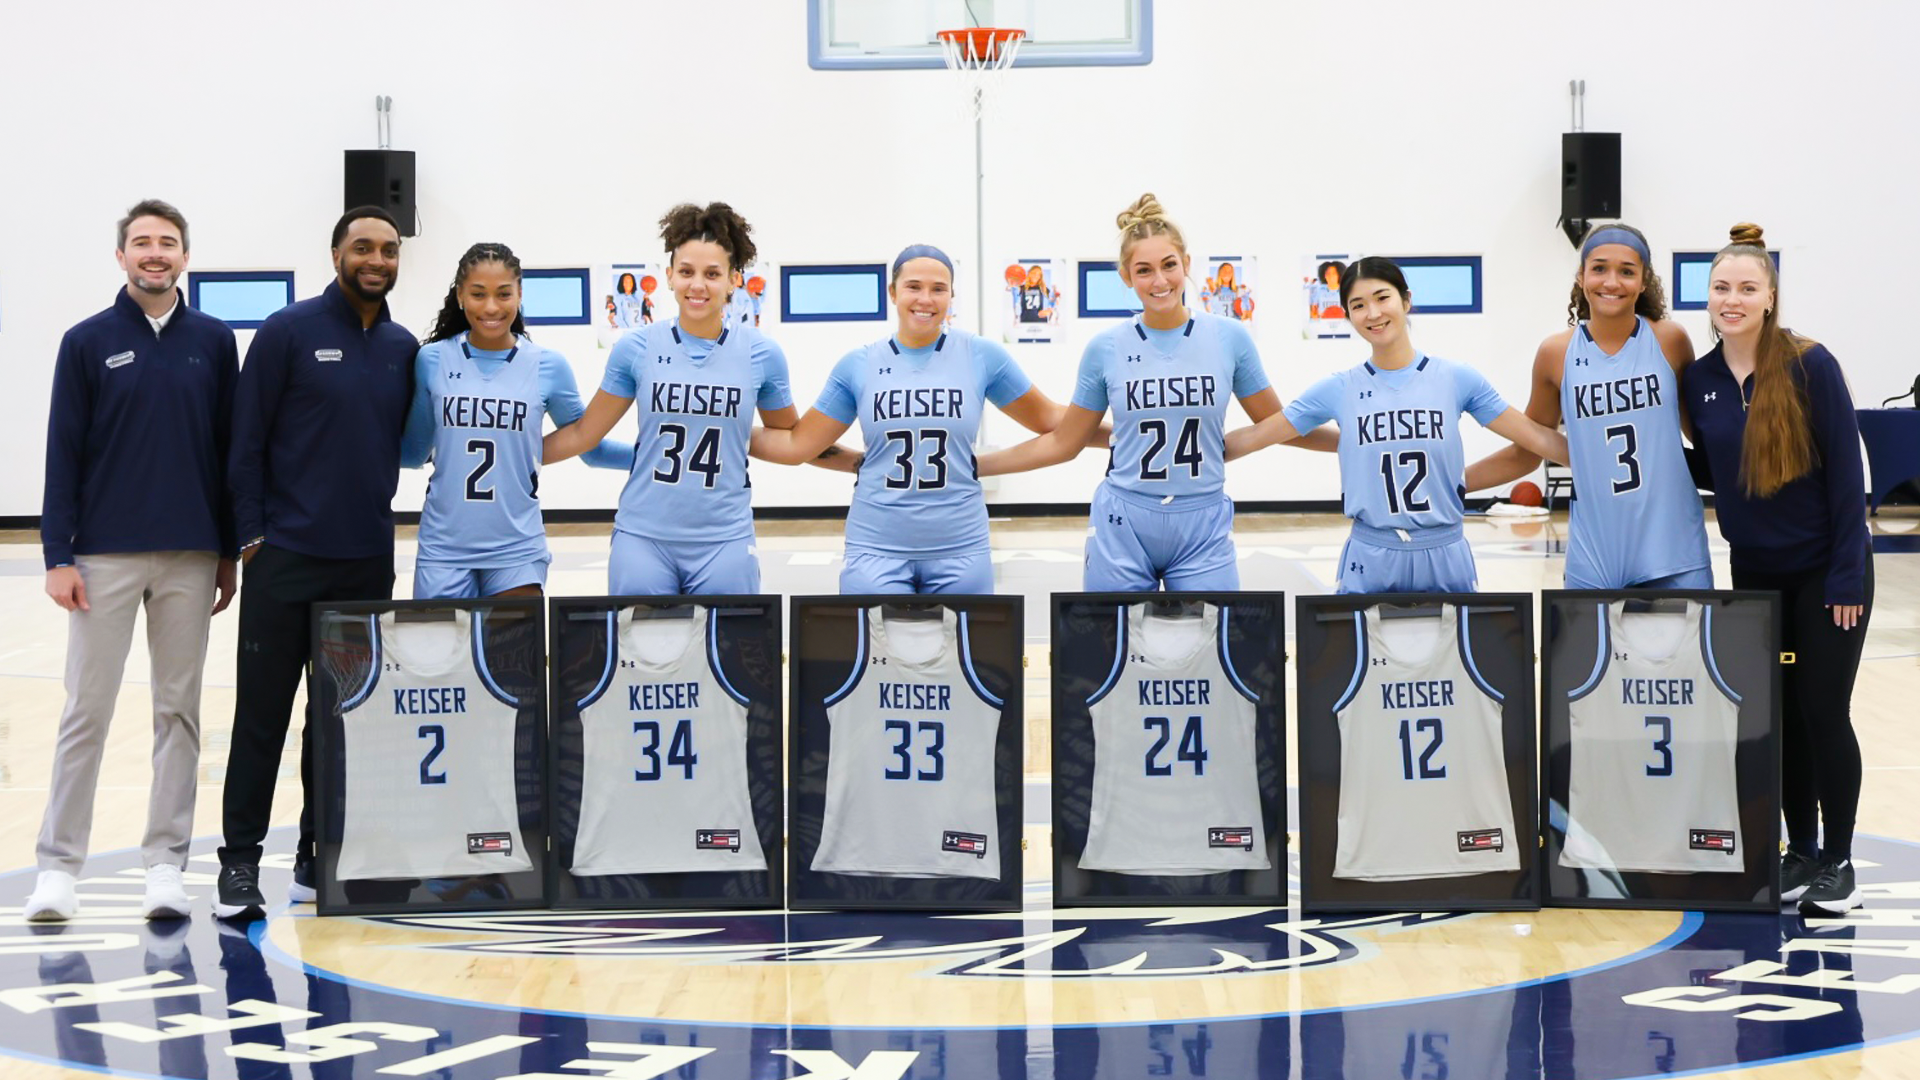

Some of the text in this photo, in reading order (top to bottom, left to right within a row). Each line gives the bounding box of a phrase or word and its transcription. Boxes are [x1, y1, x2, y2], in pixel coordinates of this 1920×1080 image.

[1025, 295, 1040, 309] 24
[442, 396, 528, 432] KEISER
[651, 382, 741, 419] KEISER
[873, 388, 963, 423] KEISER
[1126, 375, 1215, 411] KEISER
[1574, 373, 1662, 419] KEISER
[1139, 418, 1203, 480] 24
[1357, 409, 1444, 446] KEISER
[466, 440, 495, 501] 2
[654, 424, 721, 488] 34
[886, 429, 948, 490] 33
[1606, 424, 1641, 494] 3
[1381, 451, 1430, 514] 12
[393, 687, 466, 715] KEISER
[628, 682, 699, 711] KEISER
[879, 682, 951, 711] KEISER
[1138, 679, 1210, 706] KEISER
[1381, 680, 1454, 709] KEISER
[1622, 678, 1693, 705] KEISER
[418, 725, 446, 785] 2
[633, 719, 698, 782] 34
[885, 719, 944, 782] 33
[1144, 716, 1208, 776] 24
[1399, 718, 1446, 780] 12
[1645, 716, 1673, 777] 3
